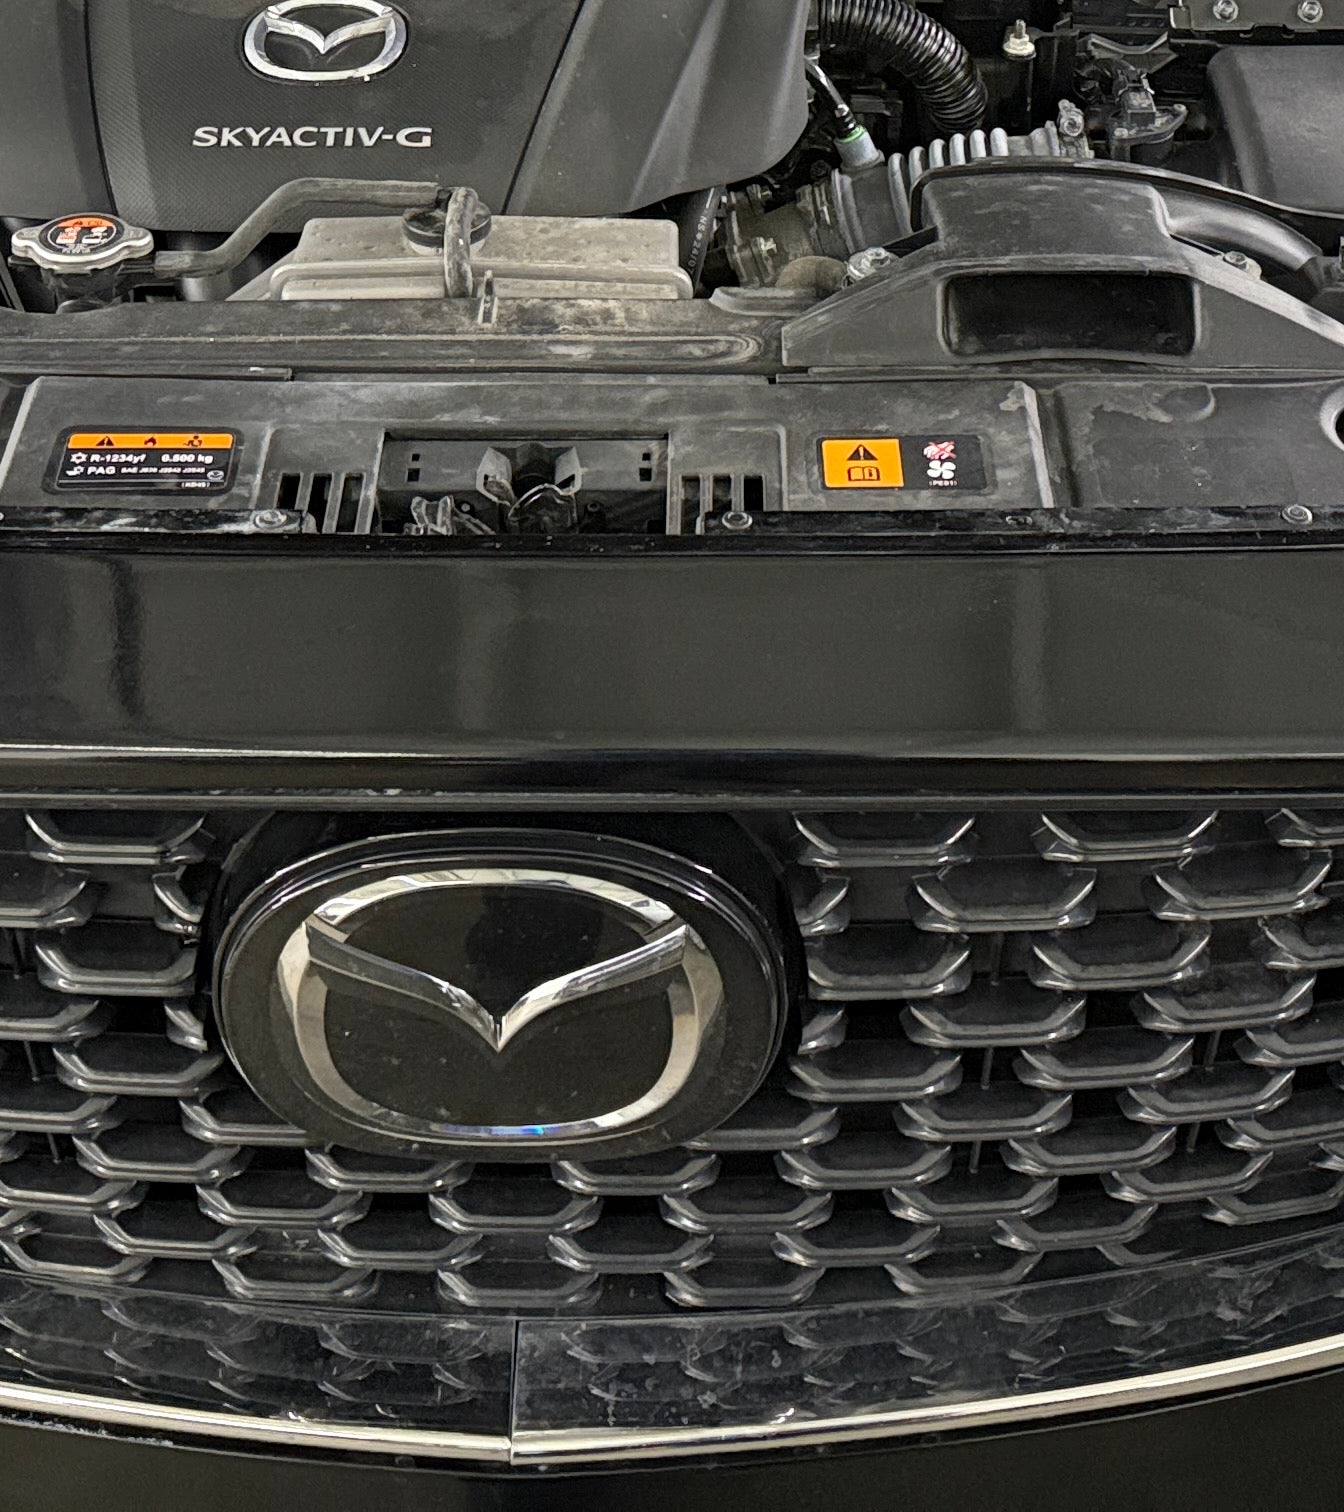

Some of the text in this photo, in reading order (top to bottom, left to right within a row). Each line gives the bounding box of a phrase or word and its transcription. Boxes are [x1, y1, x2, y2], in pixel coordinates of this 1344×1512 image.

[192, 126, 433, 148] SKYACTIV-G
[89, 453, 146, 464] R-1234yf
[197, 453, 214, 464] kg
[87, 466, 116, 475] PAG
